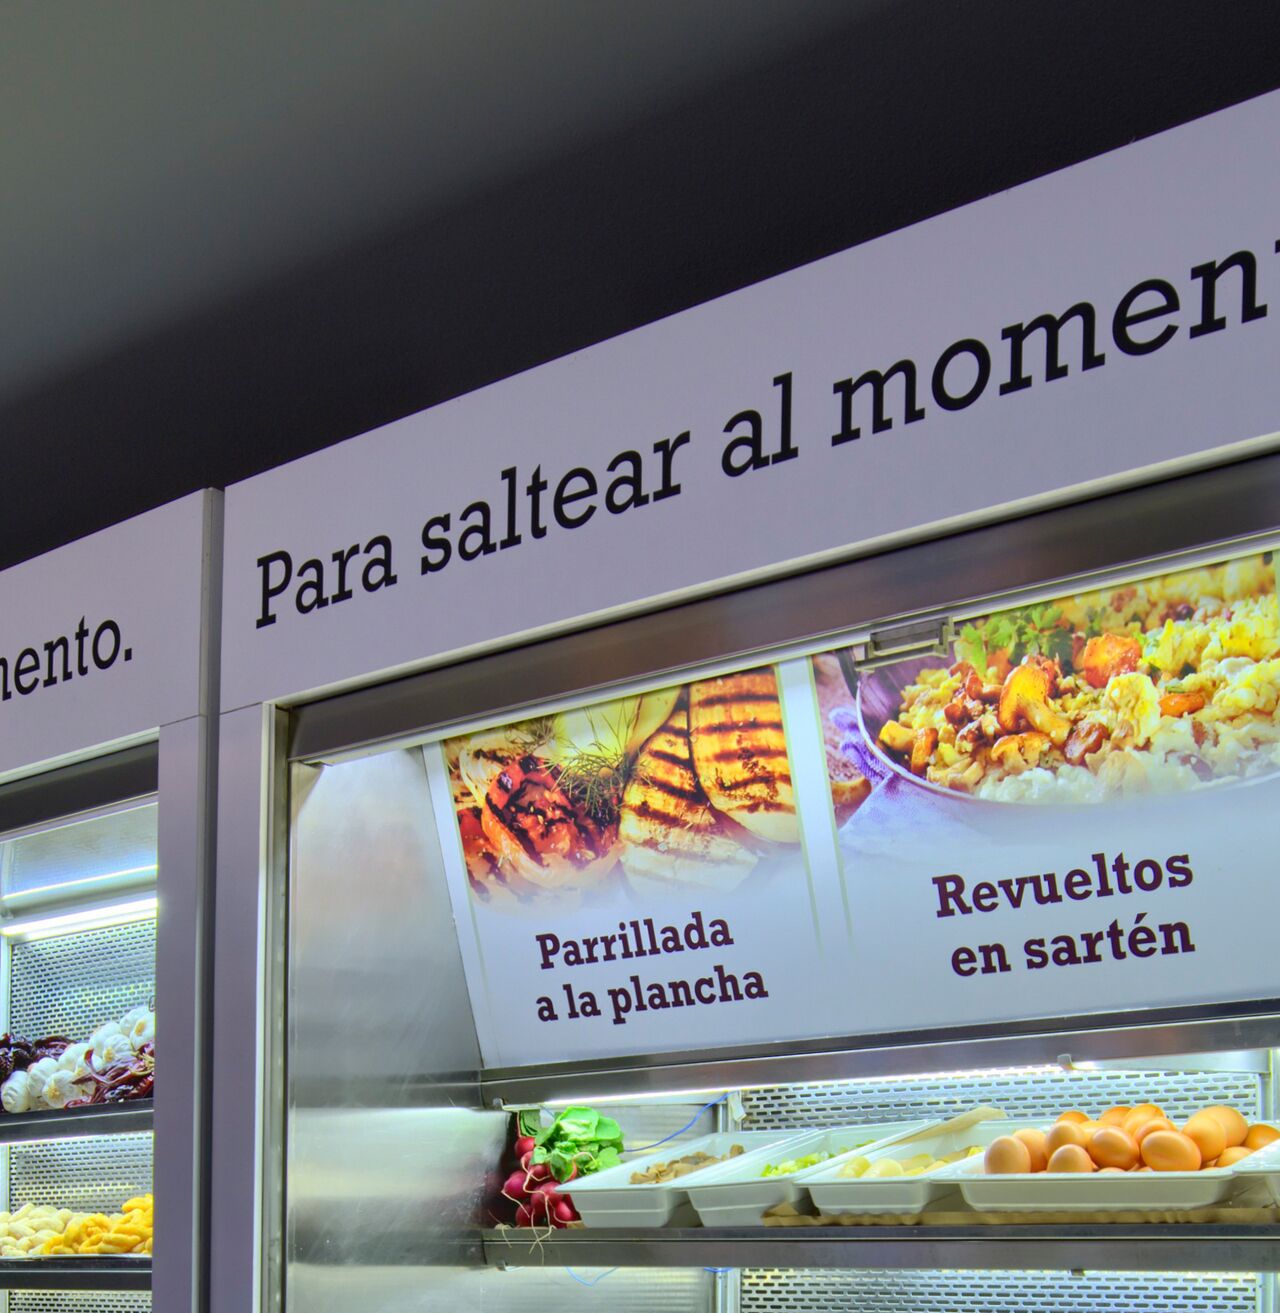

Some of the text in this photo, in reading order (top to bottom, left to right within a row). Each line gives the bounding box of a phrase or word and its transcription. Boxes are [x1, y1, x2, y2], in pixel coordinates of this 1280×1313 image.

[256, 536, 397, 629] Para
[421, 431, 690, 575] saltear
[722, 372, 798, 477] al
[932, 853, 1192, 917] Revueltos
[536, 912, 734, 969] Parrillada
[952, 913, 1195, 976] en sartén
[536, 965, 768, 1025] a la plancha
